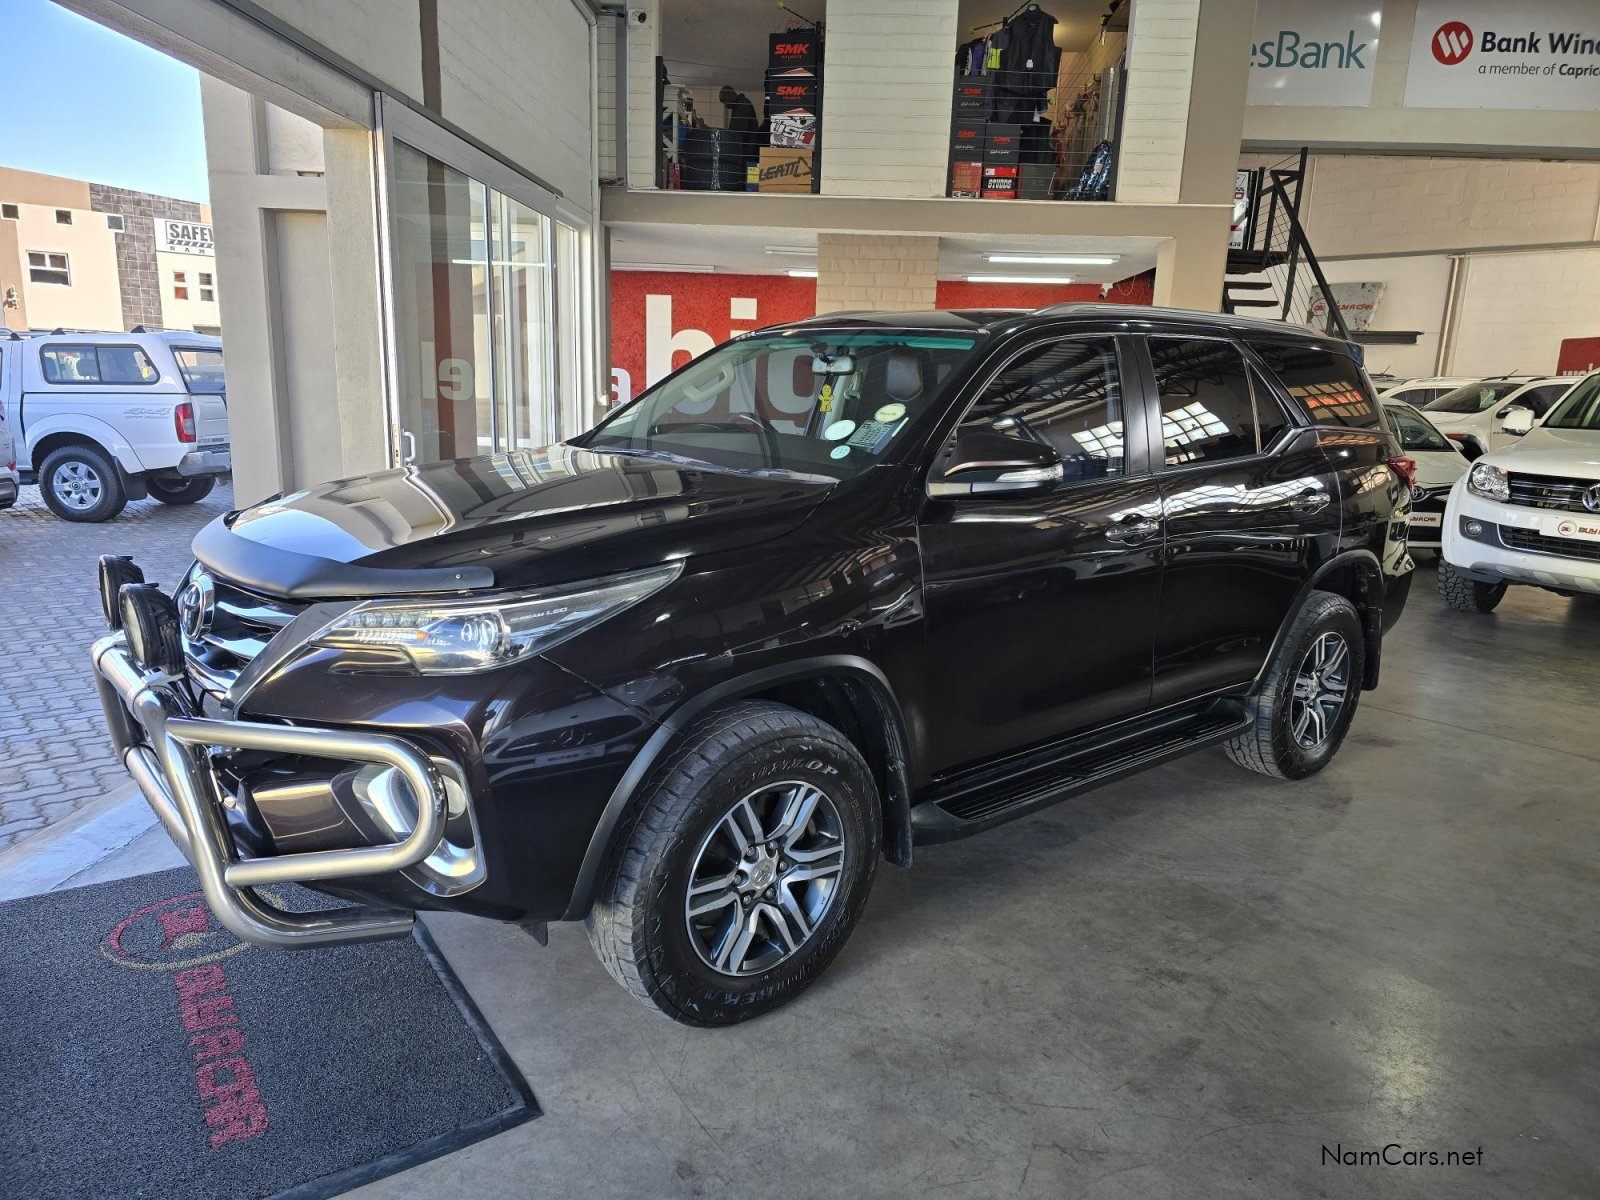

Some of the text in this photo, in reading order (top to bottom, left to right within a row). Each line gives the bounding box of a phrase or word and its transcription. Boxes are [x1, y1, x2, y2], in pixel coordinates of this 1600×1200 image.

[773, 43, 811, 56] SMK
[1480, 31, 1541, 53] Bank
[1478, 62, 1600, 79] a member of Capric
[776, 85, 809, 96] SMK
